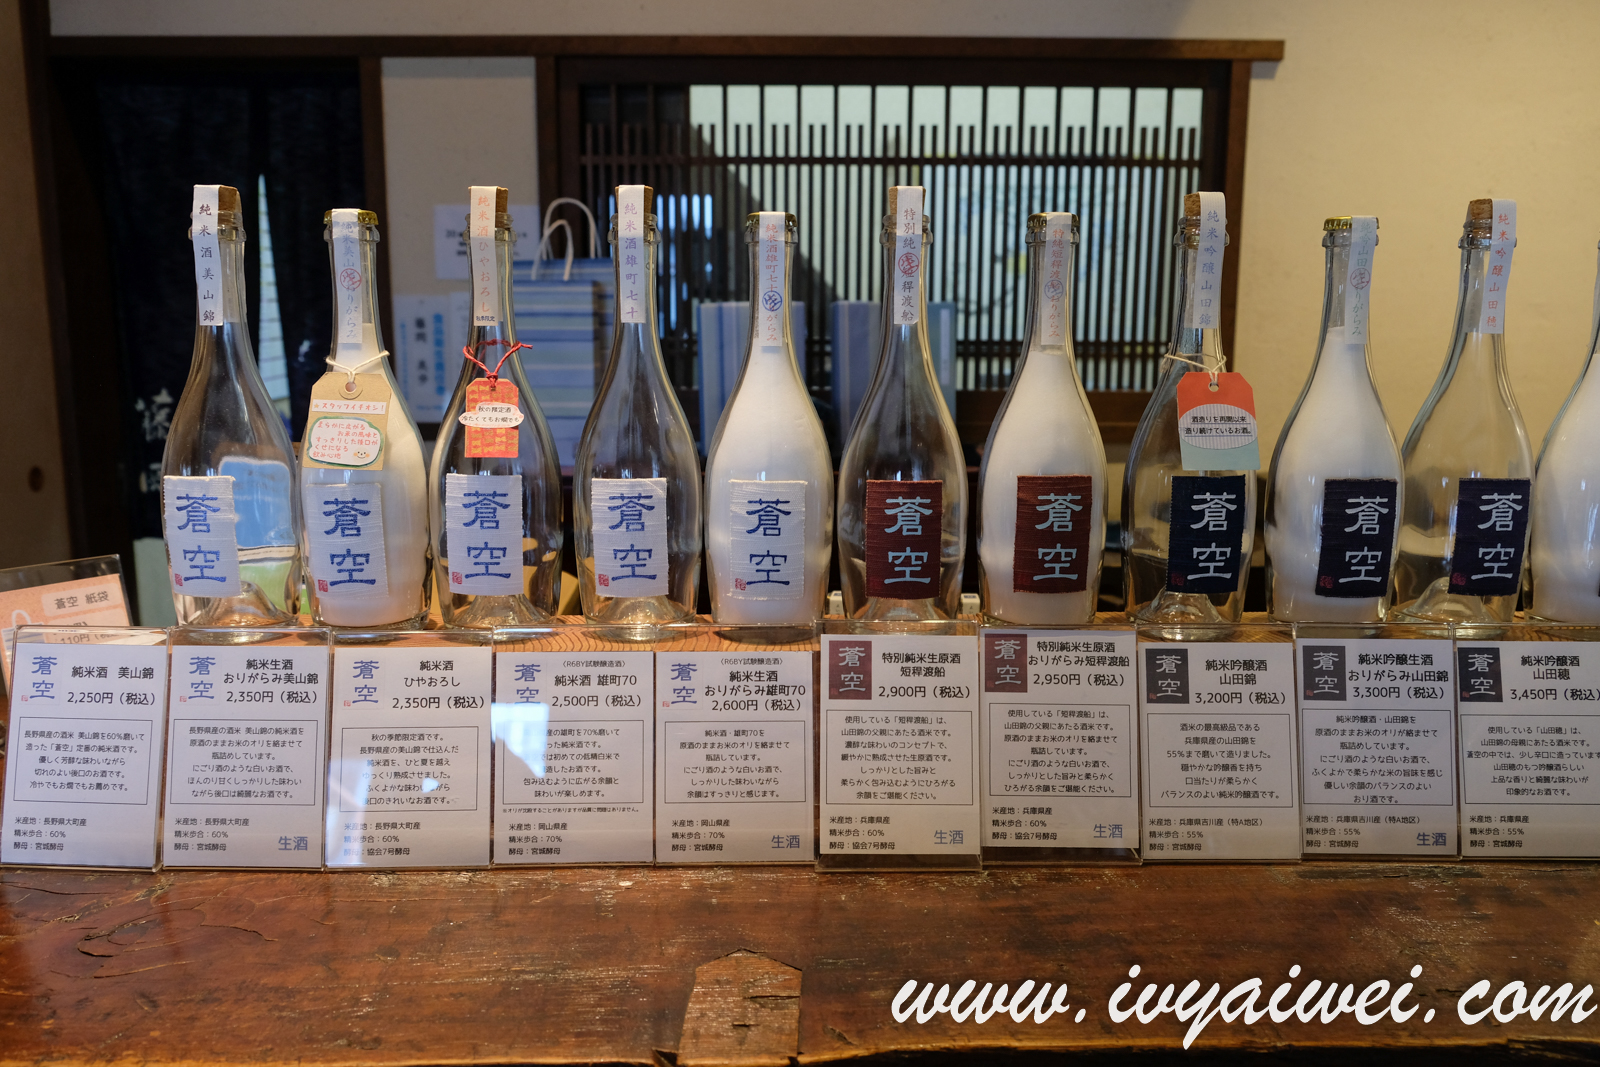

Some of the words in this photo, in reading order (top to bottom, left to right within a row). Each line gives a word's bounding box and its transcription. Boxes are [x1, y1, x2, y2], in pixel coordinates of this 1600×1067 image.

[477, 196, 490, 312] 純米酒ひやおろし
[199, 204, 215, 322] 純米酒美山錦
[624, 203, 638, 318] 純米酒雄町七十
[1199, 211, 1219, 325] 純米吟醸山田錦
[1486, 214, 1510, 327] 純米吟醸山田穂
[176, 494, 227, 582] 蒼空
[462, 491, 511, 579] 蒼空
[608, 493, 657, 581] 蒼空
[884, 496, 933, 584] 蒼空
[1033, 493, 1083, 581] 蒼空
[1187, 492, 1237, 580] 蒼空
[1338, 496, 1389, 583] 蒼空
[1471, 492, 1522, 580] 蒼空
[323, 498, 376, 586] 蒼空
[746, 499, 791, 585] 蒼空
[54, 596, 78, 609] 蒼空
[85, 591, 109, 604] 紙袋
[1037, 641, 1115, 652] 特別純米生原酒
[882, 653, 961, 664] 特別純米生原酒
[995, 640, 1021, 684] 蒼空
[1029, 655, 1130, 667] おりがらみ短稈渡船
[1358, 654, 1433, 666] 純米吟醸生酒
[1521, 656, 1580, 666] 純米吟醸酒
[246, 659, 293, 670] 純米生酒
[420, 660, 453, 672] 純米酒
[838, 647, 866, 692] 蒼空
[1205, 659, 1267, 672] 純米吟醸酒
[71, 666, 108, 679] 純米酒
[118, 667, 154, 679] 美山錦
[729, 671, 778, 682] 純米生酒
[901, 666, 945, 677] 短稈渡船
[1156, 655, 1183, 697] 蒼空
[1313, 652, 1339, 694] 蒼空
[1349, 670, 1449, 682] おりがらみ山田錦
[1468, 654, 1495, 695] 蒼空
[1533, 668, 1570, 680] 山田穂
[31, 656, 58, 700] 蒼空
[188, 656, 216, 700] 蒼空
[224, 673, 318, 684] おりがらみ美山錦
[352, 660, 380, 704] 蒼空
[404, 676, 460, 687] ひやおろし
[554, 675, 591, 686] 純米酒
[597, 675, 637, 686] 雄町70
[671, 663, 697, 704] 蒼空
[1033, 674, 1126, 686] 2,950円（税込）
[1220, 674, 1256, 685] 山田錦
[515, 664, 541, 704] 蒼空
[705, 684, 805, 697] おりがらみ雄町70
[879, 686, 972, 699] 2,900円（税込）
[1353, 686, 1445, 699] 3,300円（税込）
[1510, 688, 1600, 701] 3,450円（税込）
[67, 692, 156, 706] 2,250円（税込）
[226, 691, 318, 704] 2,350円（税込）
[392, 697, 485, 709] 2,350円（税込）
[552, 695, 643, 707] 2,500円（税込）
[1195, 692, 1287, 705] 3,200円（税込）
[712, 699, 802, 711] 2,600円（税込）
[189, 727, 241, 735] 長野県産の酒米
[245, 727, 304, 735] 美山錦の純米酒を
[1004, 722, 1114, 731] 山田錦の父親にあたる酒米です。
[25, 731, 74, 739] 長野県産の酒米
[78, 732, 144, 741] 美山錦を60%磨いて
[841, 729, 951, 737] 山田錦の父親にあたる酒米です。
[1004, 735, 1117, 743] 原酒のままお米のオリを絡ませて
[1185, 737, 1256, 745] 兵庫県産の山田錦を
[1481, 739, 1590, 747] 山田錦の母親にあたる酒米です。
[360, 746, 458, 754] 長野県産の美山錦で仕込んだ
[680, 741, 789, 749] 原酒のままお米のオリを絡ませて
[1340, 742, 1410, 750] 瓶詰めしています。
[212, 752, 276, 760] 瓶詰めしています。
[1031, 747, 1088, 755] 瓶詰しています。
[1167, 750, 1271, 759] 55%まで磨いて造りました。
[860, 766, 936, 774] しっかりとした旨みと
[1181, 764, 1262, 772] 穏やかな吟醸香を持ち
[1311, 768, 1442, 777] ふくよかで柔らかな米の旨味を感じ
[1494, 763, 1584, 771] 山田穂のもつ吟醸酒らしい
[35, 769, 125, 779] 切れのよい後口のお酒です。
[1008, 772, 1114, 781] しっかりとした旨みと柔らかく
[188, 777, 301, 786] ほんのり甘くしっかりした味わい
[524, 777, 618, 785] 包み込むように広がる余韻と
[691, 778, 779, 786] しっかりした味わいながら
[841, 779, 955, 787] 柔らかく包み込むようにひろがる
[1185, 777, 1257, 785] 口当たりが柔らかく
[1324, 782, 1431, 790] 優しい余韻のバランスのよい
[1004, 784, 1115, 793] ひろがる余韻をご堪能ください。
[1506, 788, 1571, 796] 印象的なお酒です。
[856, 791, 937, 799] 余韻をご堪能ください。
[1161, 790, 1280, 799] バランスのよい純米吟醸酒です。
[1354, 795, 1399, 803] おり酒です。
[992, 807, 1052, 815] 米産地：兵庫県産
[15, 817, 86, 826] 米産地：長野県大町産
[175, 818, 249, 827] 米産地：長野県大町産
[672, 819, 730, 827] 米産地：岡山県産
[829, 816, 890, 824] 米産地：兵庫県産
[1469, 815, 1529, 824] 米産地：兵庫県産
[344, 822, 420, 831] 米産地：長野県大町産
[509, 823, 567, 831] 米産地：岡山県産
[1093, 824, 1123, 839] 生酒
[1306, 828, 1360, 836] 精米歩合：55%
[1469, 827, 1524, 836] 精米歩合：55%
[14, 830, 66, 838] 精米歩合：60%
[672, 832, 725, 840] 精米歩合：70%
[829, 829, 884, 837] 精米歩合：60%
[934, 830, 963, 845] 生酒
[992, 832, 1057, 840] 酵母：協会7号酵母
[278, 836, 308, 850] 生酒
[344, 835, 399, 843] 精米歩合：60%
[509, 835, 562, 843] 精米歩合：70%
[771, 835, 800, 849] 生酒
[1306, 840, 1358, 848] 酵母：宮城酵母
[1417, 832, 1446, 847] 生酒
[1470, 840, 1522, 848] 酵母：宮城酵母
[14, 842, 63, 851] 酵母：宮城酵母
[174, 843, 226, 851] 酵母：宮城酵母
[672, 844, 723, 852] 酵母：宮城酵母
[829, 841, 895, 850] 酵母：協会7号酵母
[1149, 843, 1201, 851] 酵母：宮城酵母
[509, 848, 560, 856] 酵母：宮城酵母
